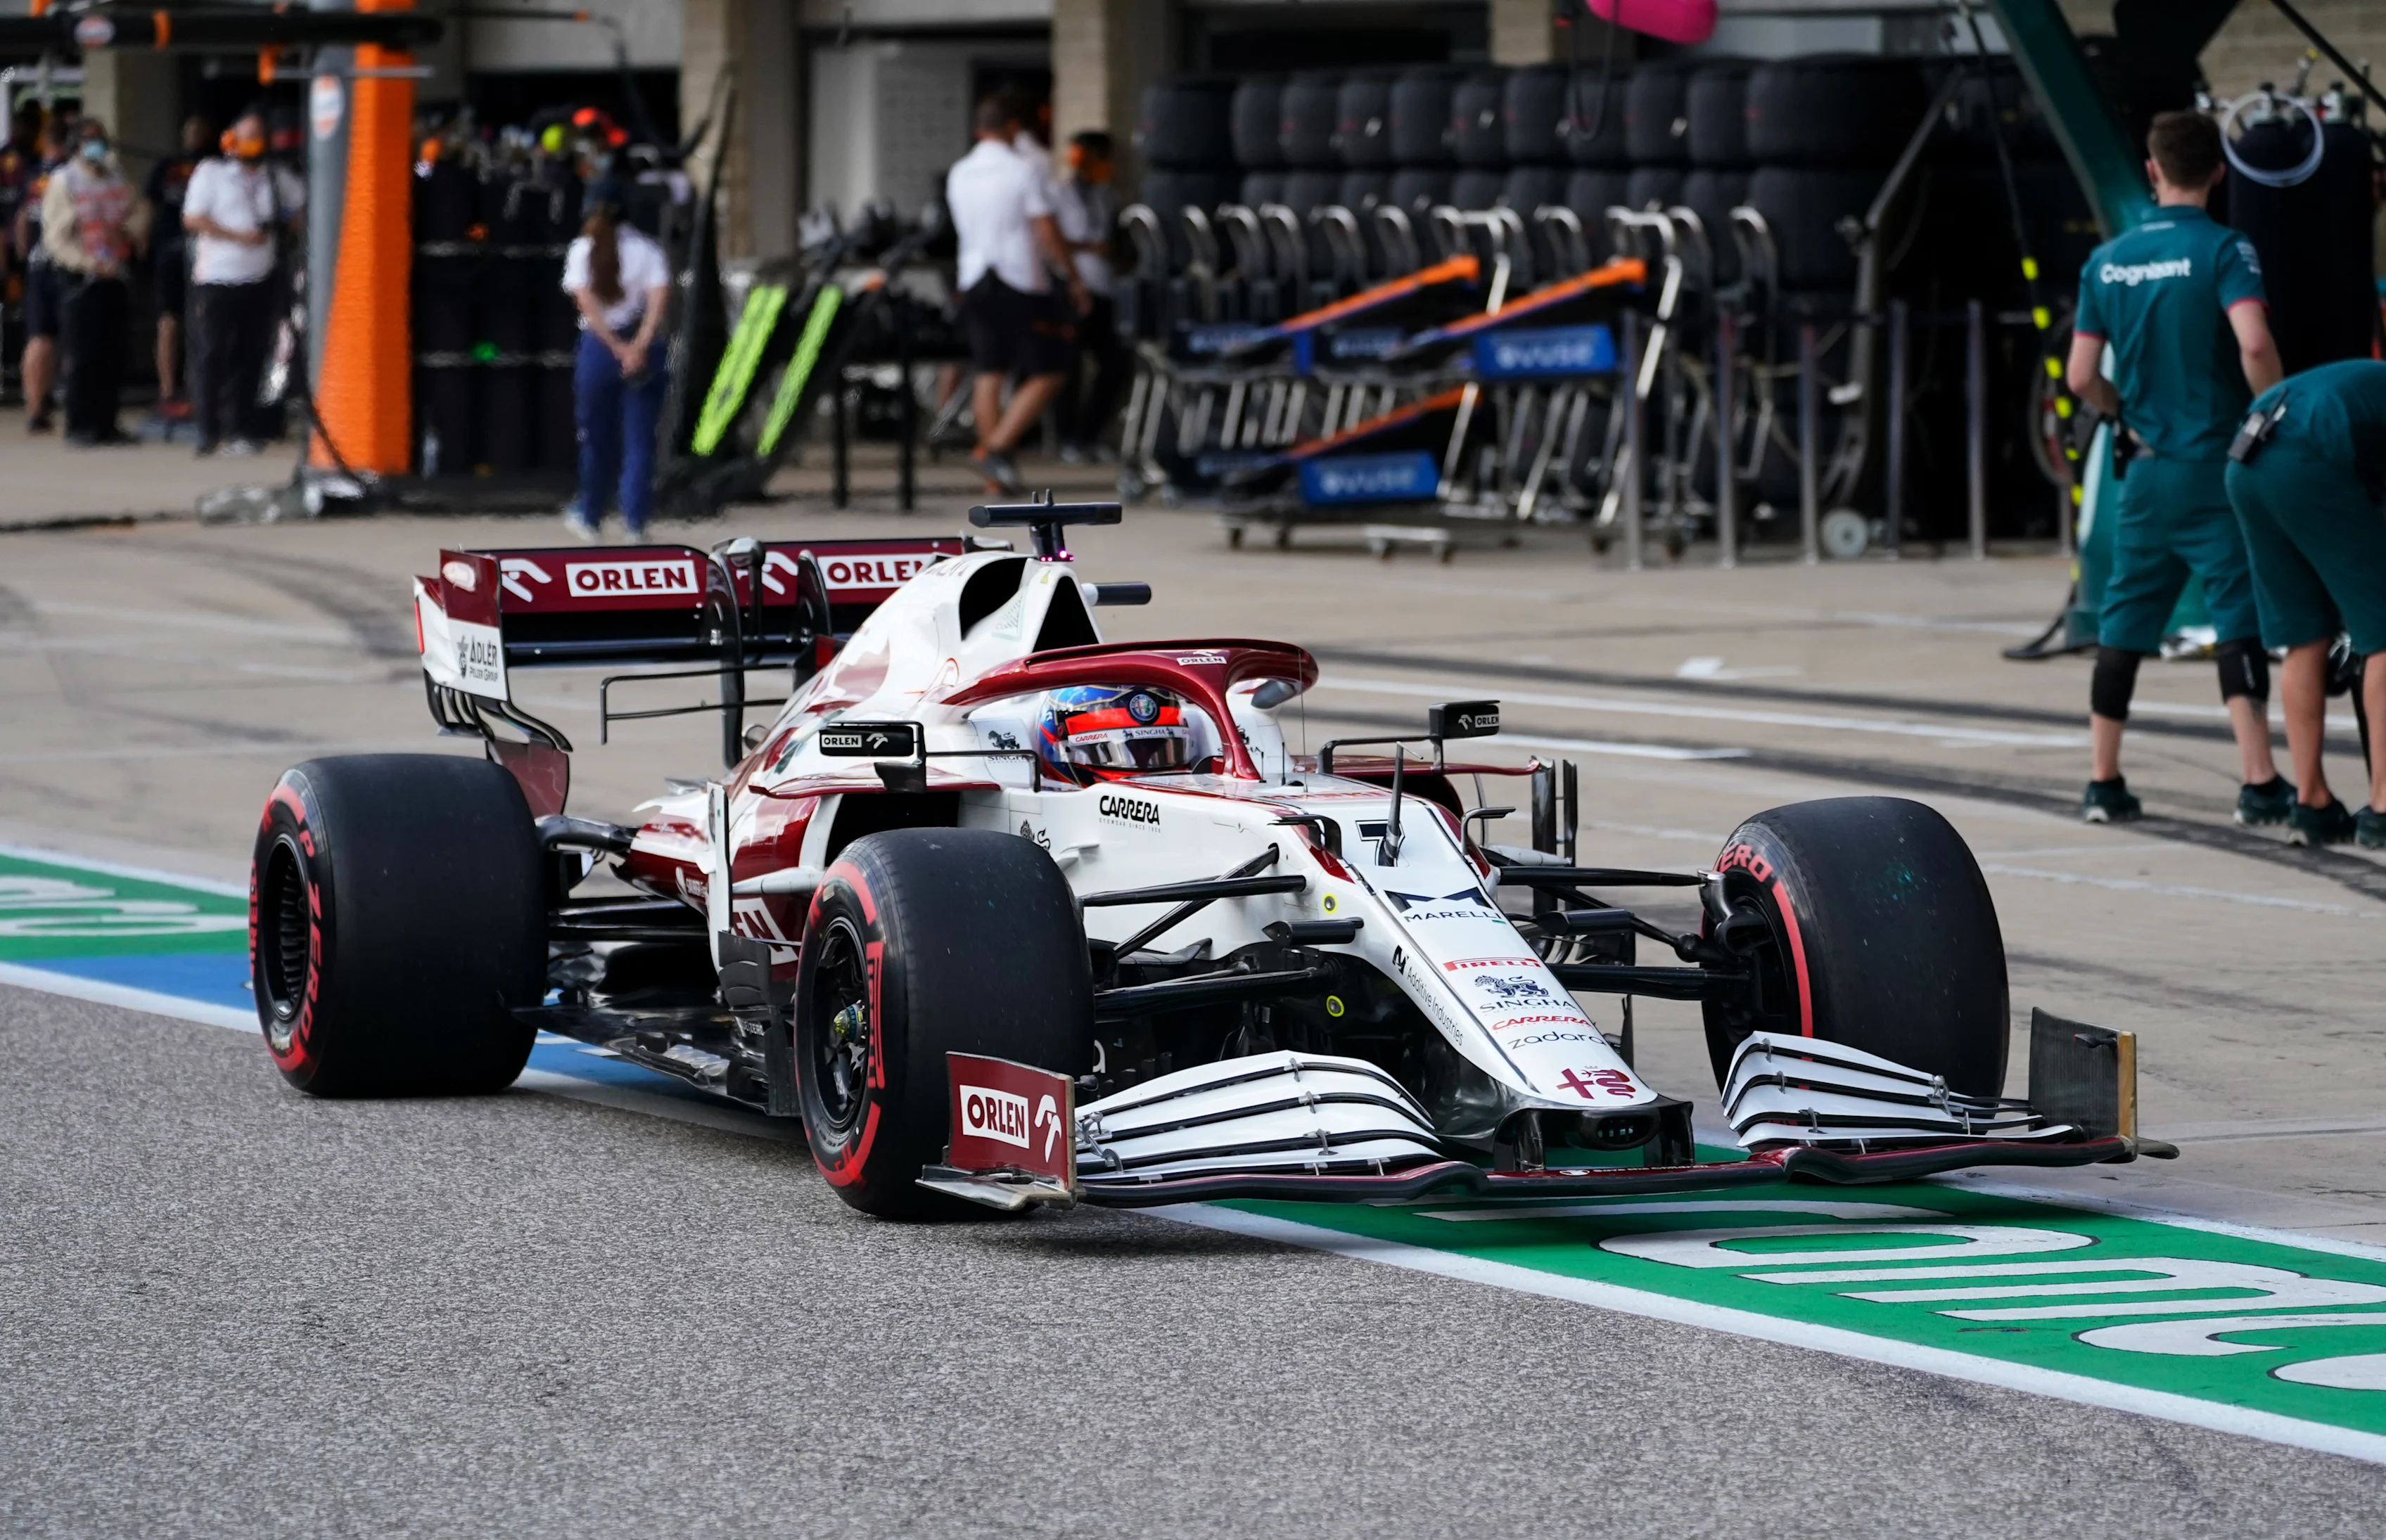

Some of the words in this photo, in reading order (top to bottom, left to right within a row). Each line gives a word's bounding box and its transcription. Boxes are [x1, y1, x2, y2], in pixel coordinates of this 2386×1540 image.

[2100, 257, 2191, 287] Cognizant
[575, 567, 687, 591] ORLEN
[827, 560, 924, 584] ORLE
[470, 636, 497, 668] ADLER
[824, 737, 859, 745] ORLEN
[1075, 733, 1108, 743] CARRERA
[1135, 728, 1166, 736] SINGHA
[1099, 795, 1160, 826] CARRERA
[1355, 820, 1405, 867] 7
[1404, 911, 1502, 923] MARELLI
[300, 880, 322, 1042] ZERO
[1443, 957, 1541, 972] PIRELLI
[1408, 967, 1432, 1007] Additive
[1432, 996, 1464, 1046] Industries
[1479, 999, 1577, 1013] SINGHA
[1492, 1015, 1593, 1030] CARRERA
[1507, 1032, 1607, 1050] zadara
[967, 1094, 1025, 1138] ORLEN
